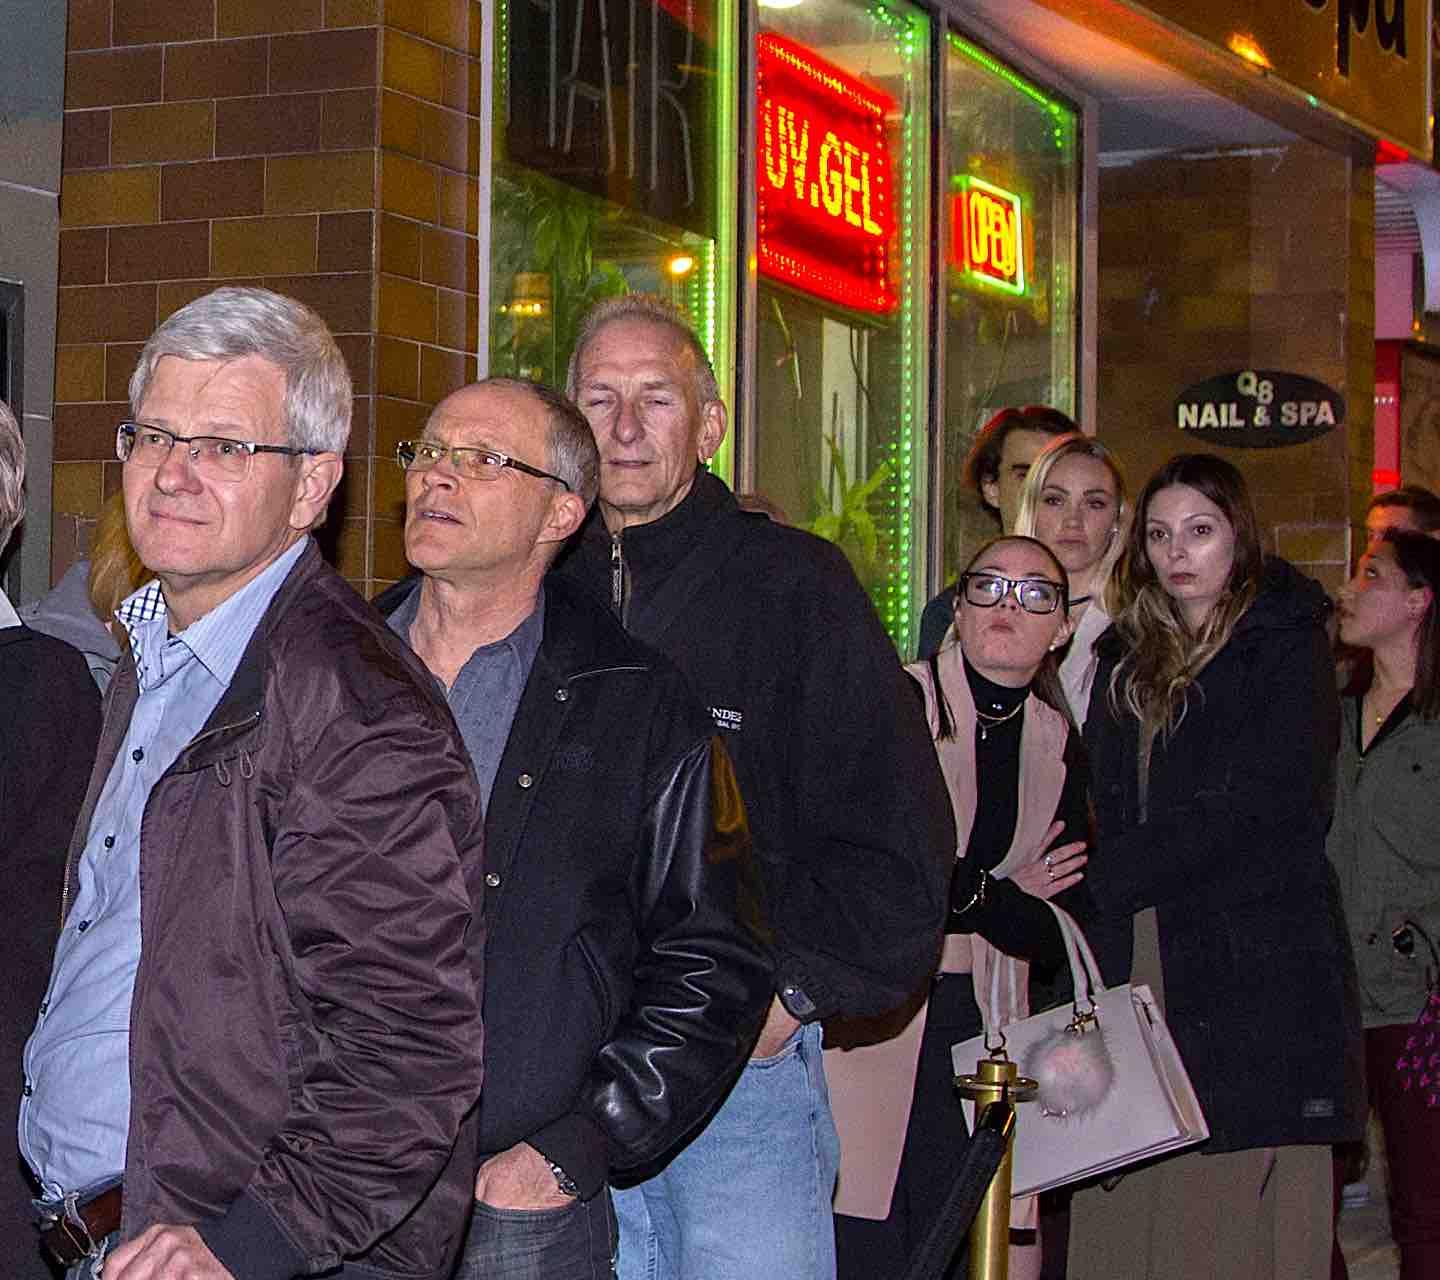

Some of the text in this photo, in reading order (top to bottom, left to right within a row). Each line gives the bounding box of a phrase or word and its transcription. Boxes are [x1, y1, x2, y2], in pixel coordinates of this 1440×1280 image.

[969, 191, 1018, 278] OPEN
[1237, 371, 1274, 405] Q8
[1178, 401, 1336, 429] NAIL & SPA
